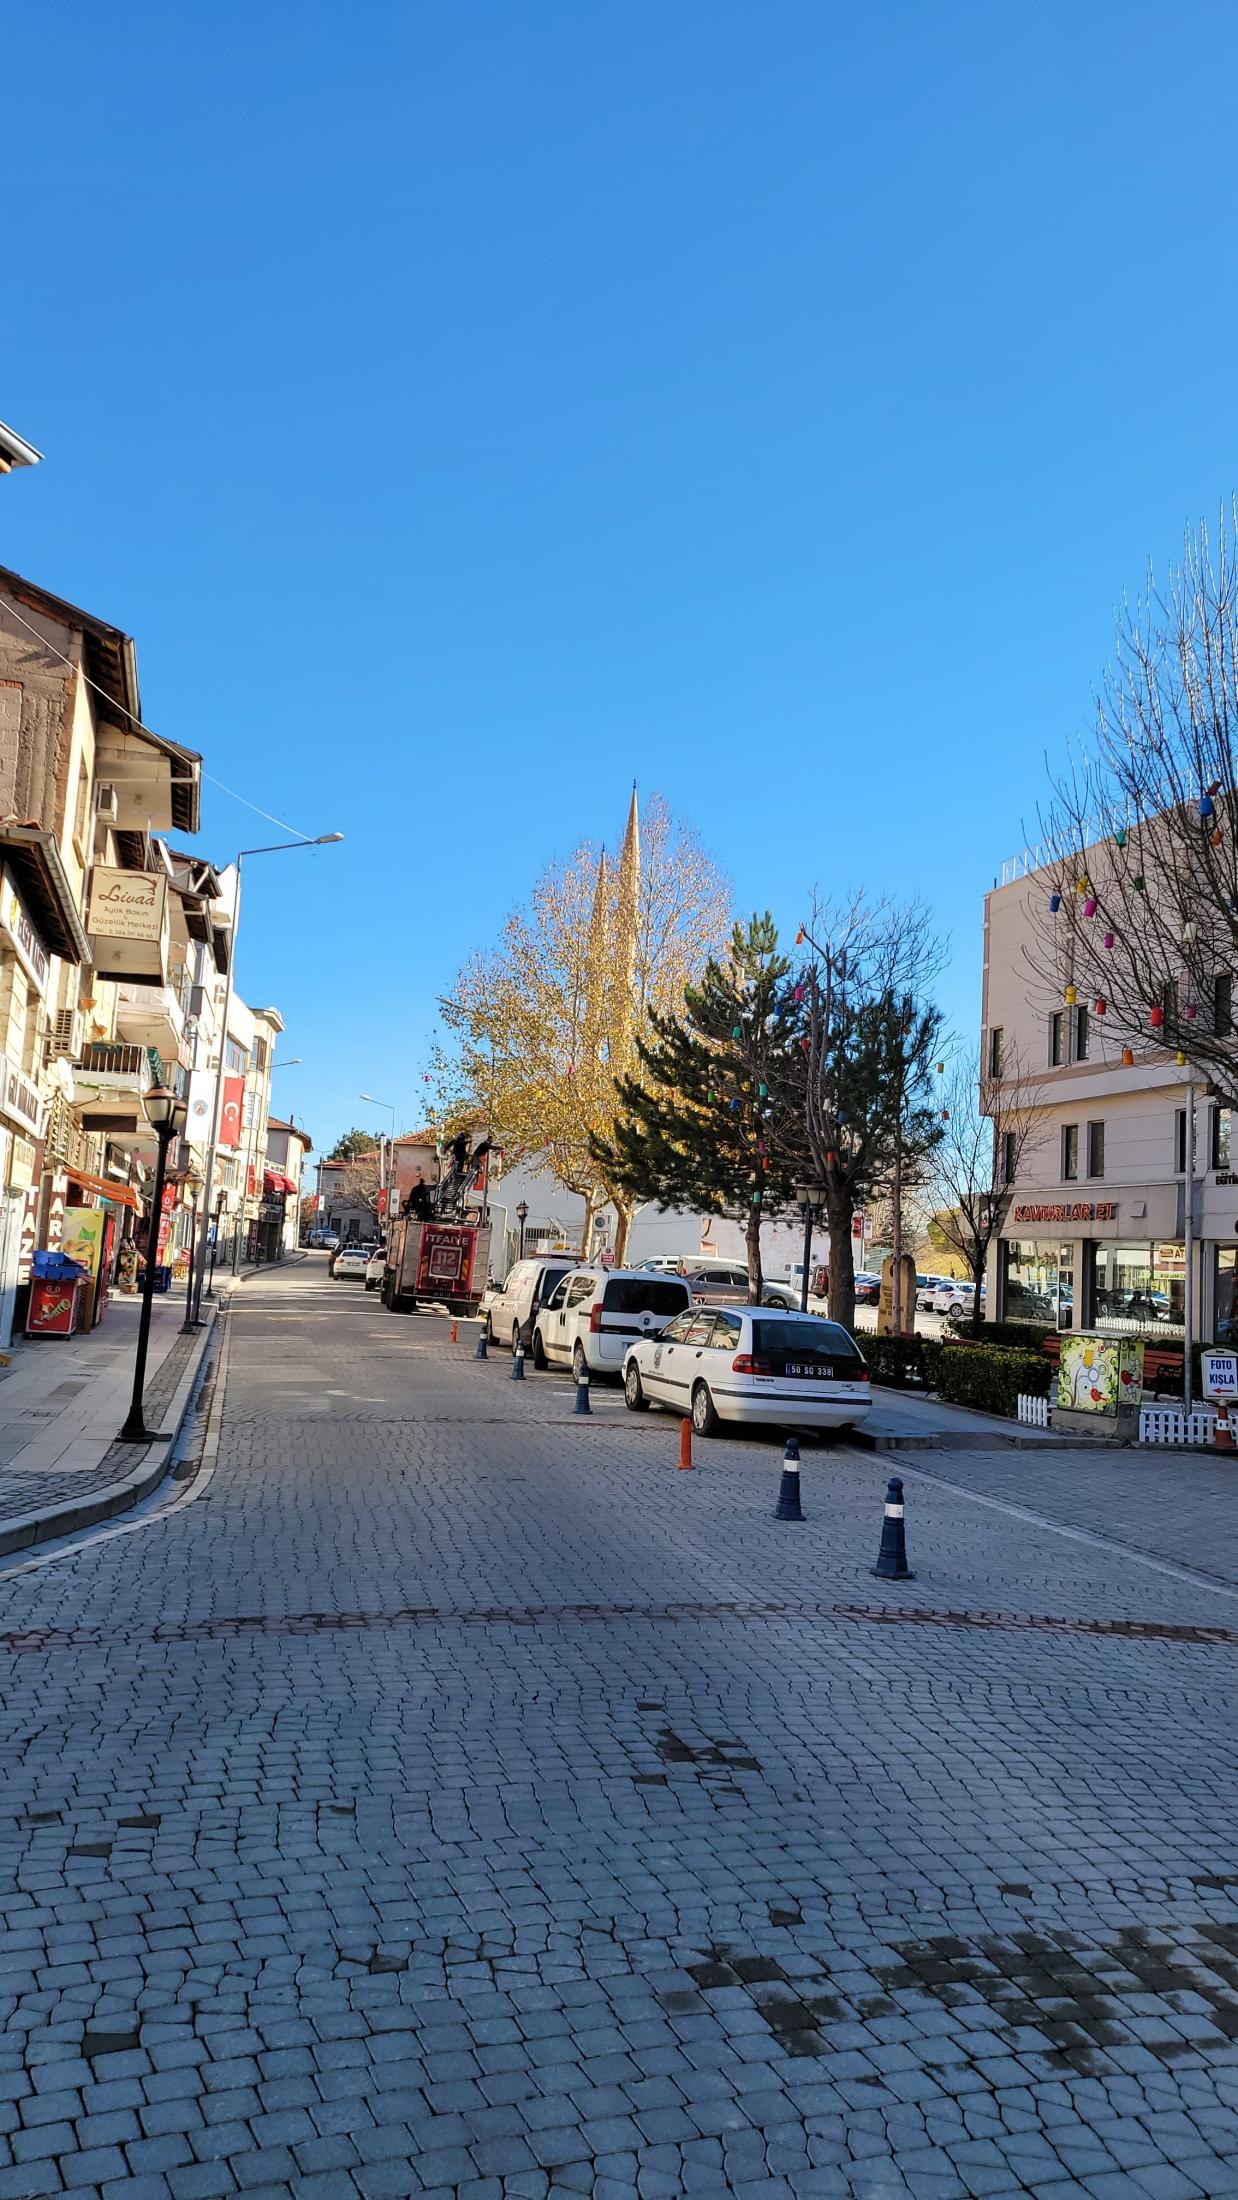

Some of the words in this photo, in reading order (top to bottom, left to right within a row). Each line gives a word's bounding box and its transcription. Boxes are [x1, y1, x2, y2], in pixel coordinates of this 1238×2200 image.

[98, 884, 156, 906] Livaa
[104, 906, 123, 914] Ayak
[125, 908, 149, 917] Bakım
[92, 916, 125, 927] Güzellik
[127, 921, 159, 930] Merkezi
[1096, 1202, 1115, 1219] ET
[18, 1186, 39, 1286] TAZE
[437, 1251, 456, 1265] 112
[791, 1365, 801, 1374] 50
[804, 1366, 814, 1375] SG
[817, 1367, 832, 1376] 338
[1210, 1359, 1232, 1370] FOTO
[1209, 1373, 1235, 1385] KIŞLA
